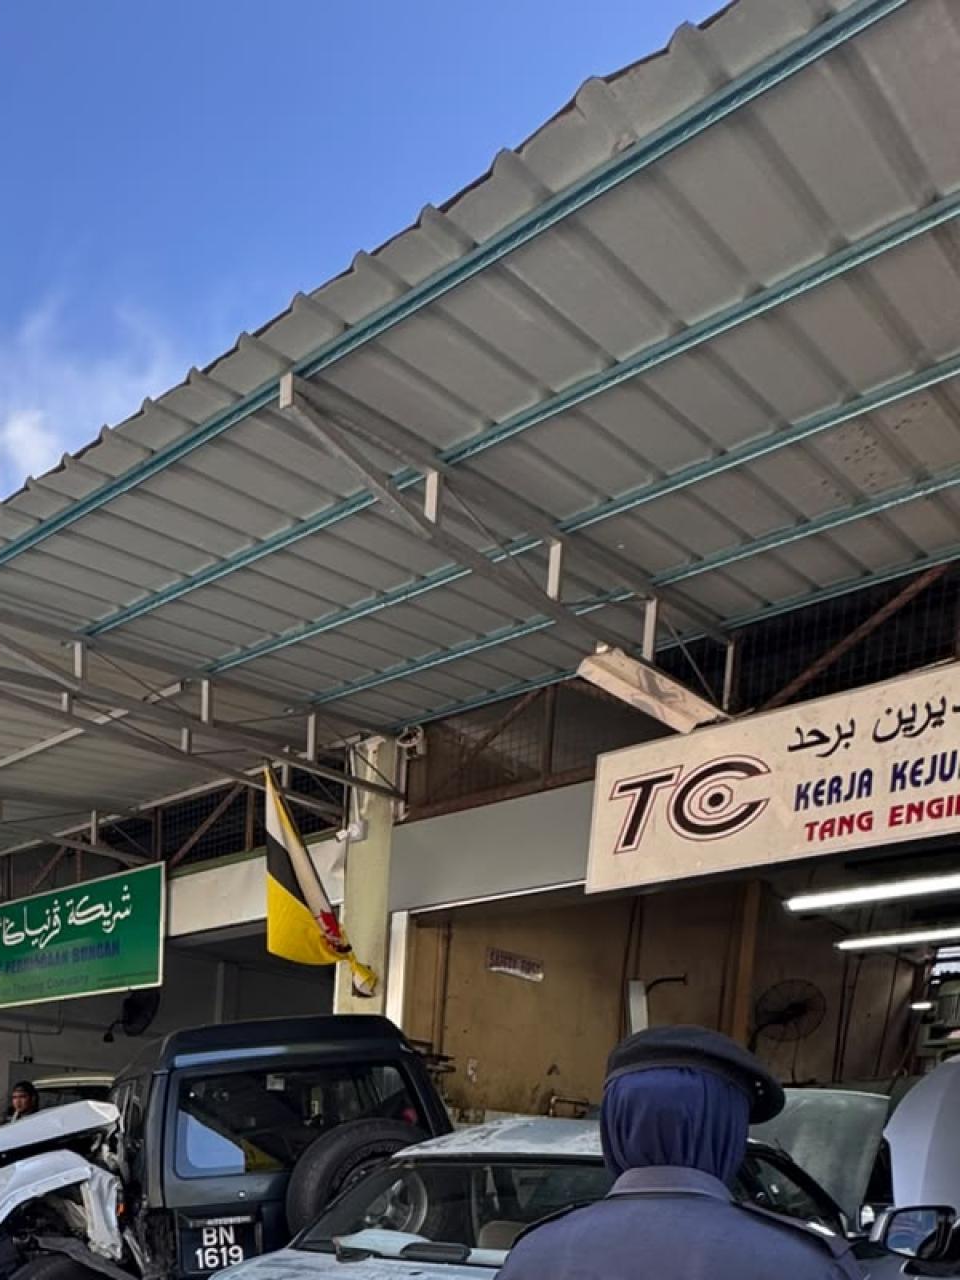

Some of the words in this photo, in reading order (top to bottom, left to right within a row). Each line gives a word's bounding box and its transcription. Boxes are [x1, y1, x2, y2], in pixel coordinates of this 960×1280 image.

[788, 718, 855, 757] برحد
[794, 768, 873, 812] KERJA
[889, 749, 960, 793] KEJU
[609, 755, 771, 855] TC
[804, 810, 873, 842] TANG
[203, 1225, 236, 1246] BN
[195, 1244, 244, 1269] 1619
